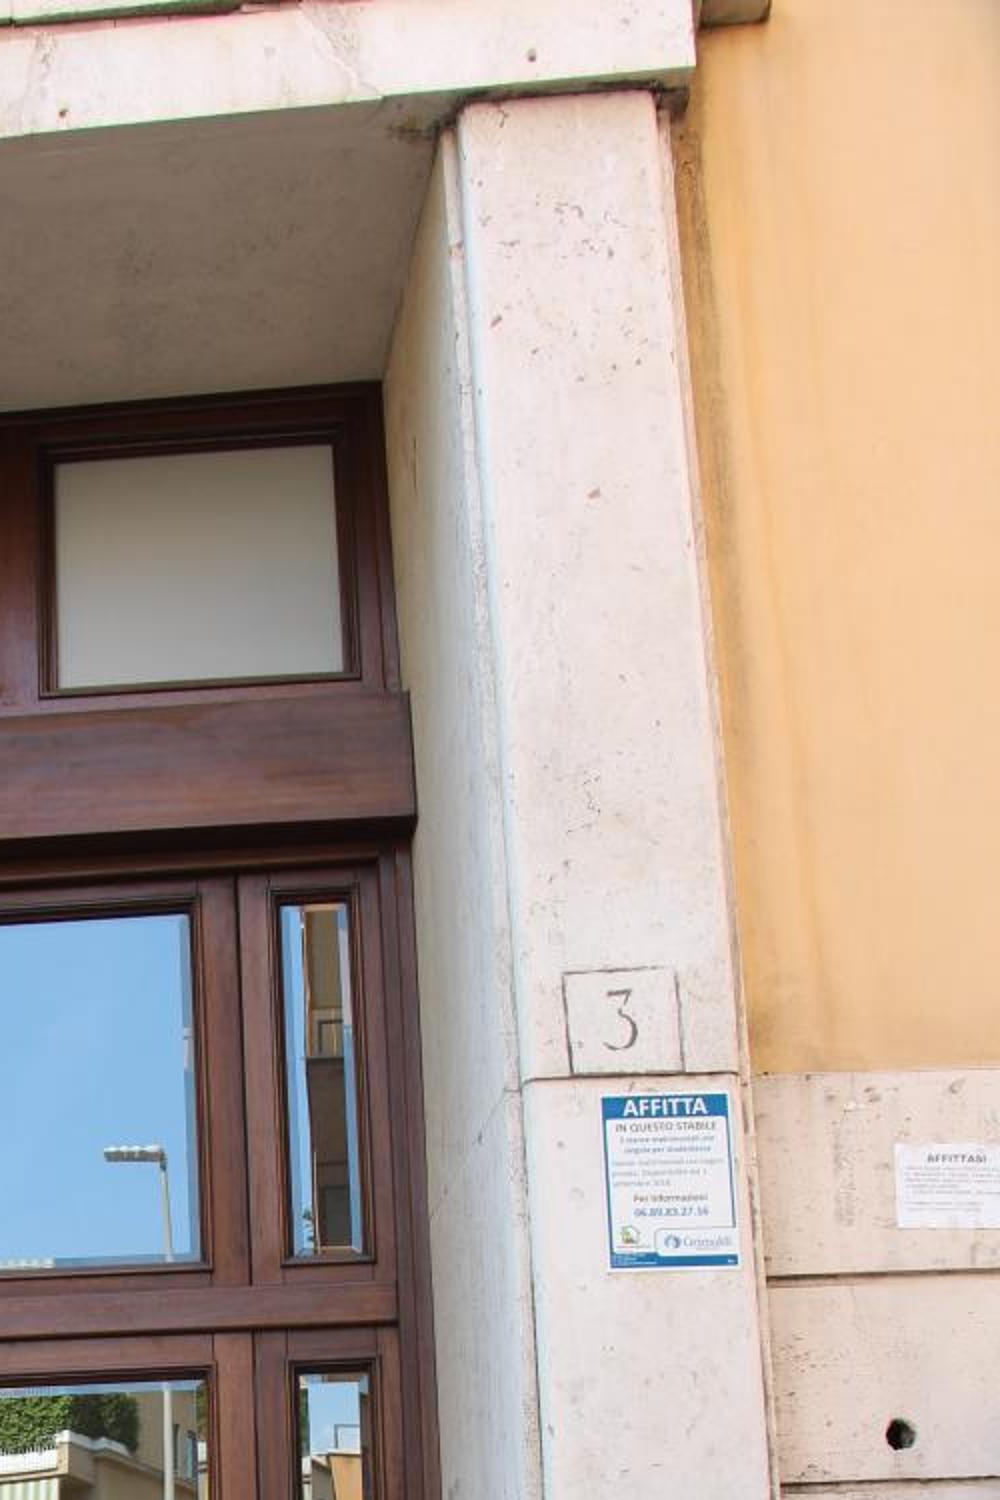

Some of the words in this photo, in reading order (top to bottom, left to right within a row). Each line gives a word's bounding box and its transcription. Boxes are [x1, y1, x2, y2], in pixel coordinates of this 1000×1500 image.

[603, 988, 638, 1051] 3
[624, 1097, 708, 1117] AFFITTA
[615, 1123, 627, 1132] IN
[630, 1121, 672, 1132] QUESTO
[676, 1120, 717, 1131] STABILE
